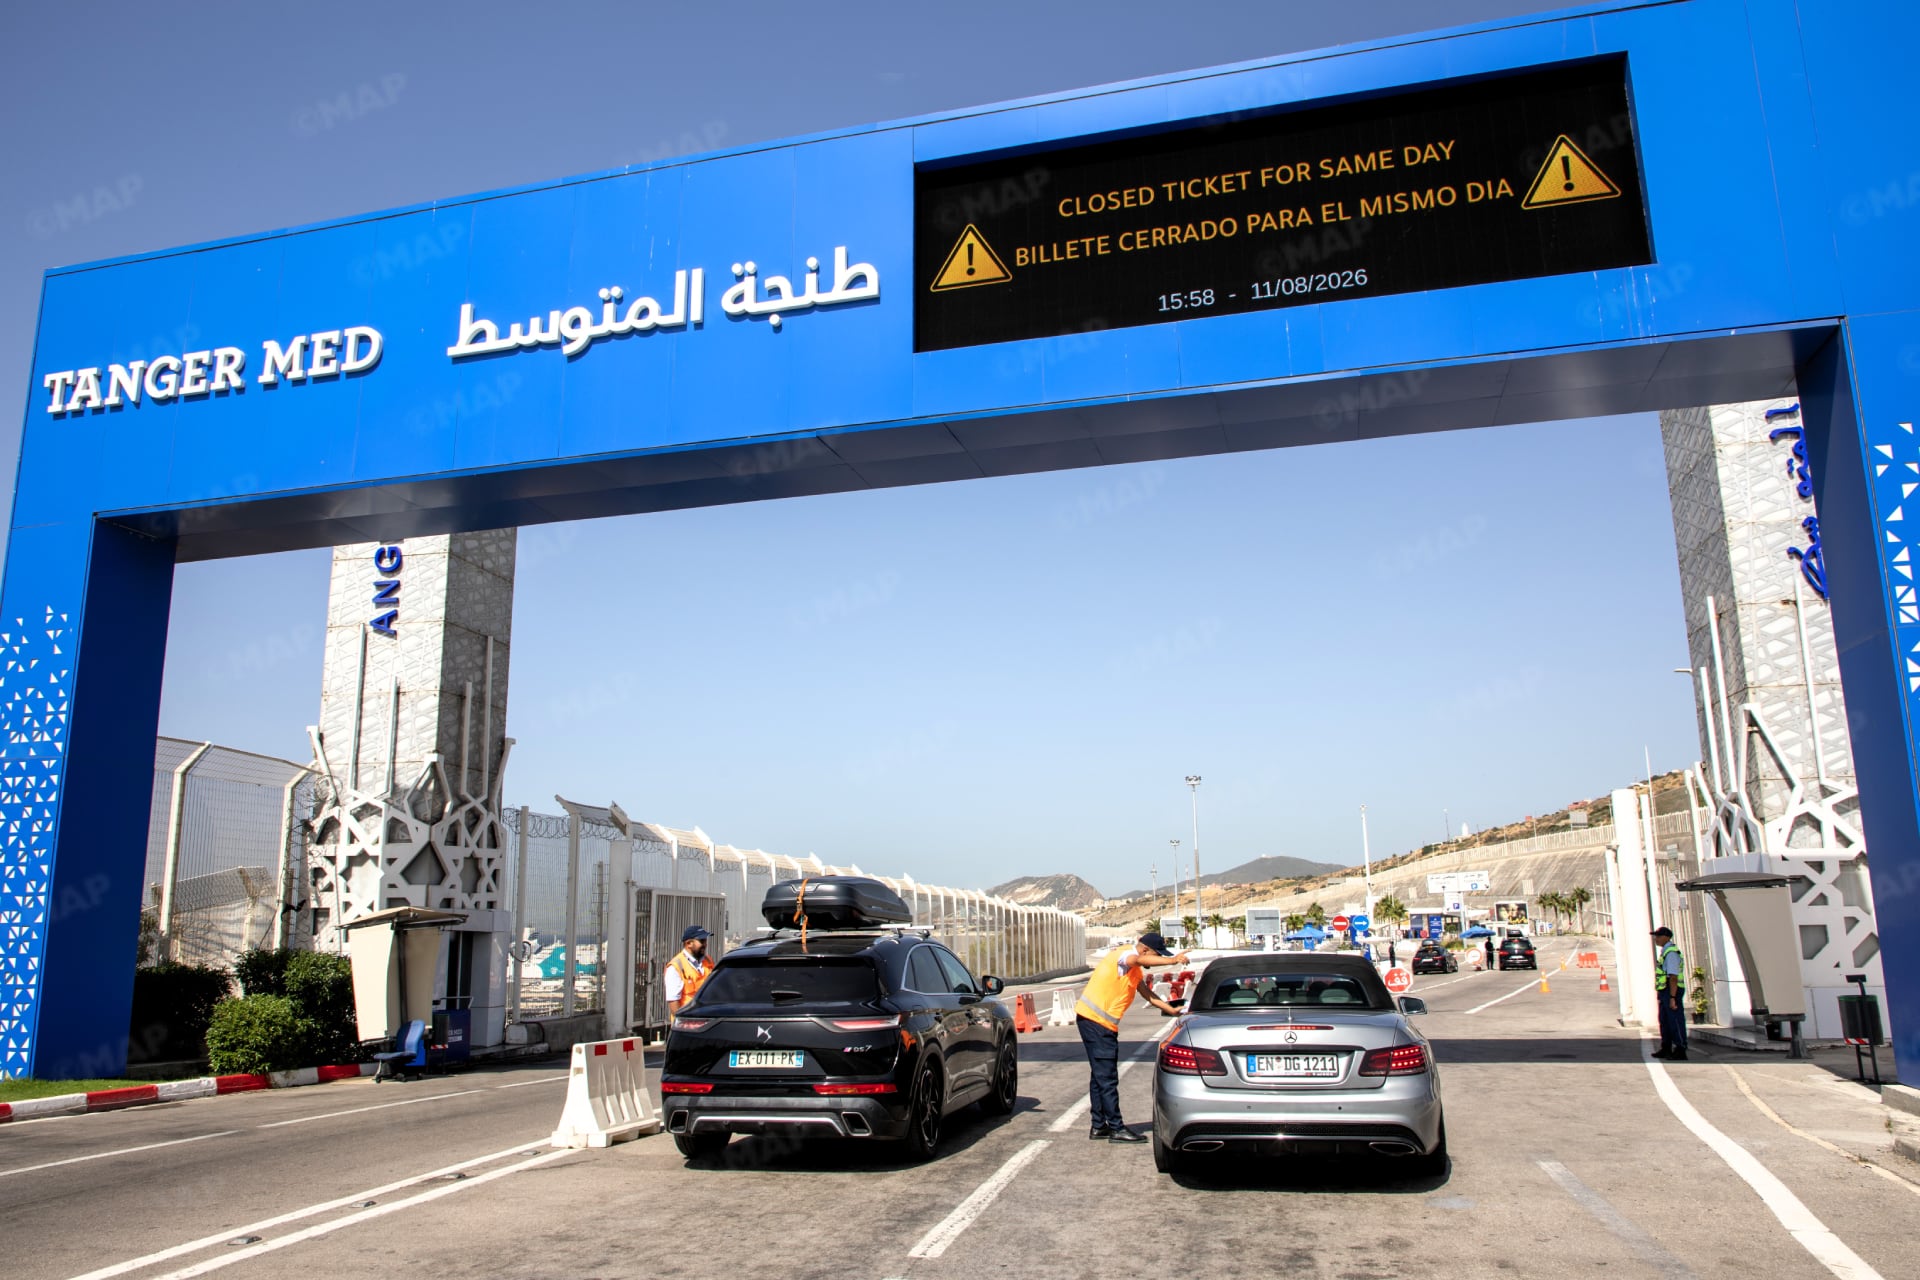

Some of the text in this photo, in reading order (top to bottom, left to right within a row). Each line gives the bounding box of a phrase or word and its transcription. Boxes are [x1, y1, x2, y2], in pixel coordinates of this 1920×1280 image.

[1058, 139, 1456, 217] CLOSED TICKET FOR SAME DAY
[1015, 177, 1515, 267] BILLETE CERRADO PARA EL MISMO DIA
[446, 245, 881, 357] طنجة المتوسط
[1158, 287, 1216, 312] 15:58
[1250, 267, 1369, 300] 11/08/2026
[43, 346, 246, 415] TANGER
[257, 325, 384, 384] MED
[369, 544, 402, 636] ANG
[738, 1052, 795, 1065] EX-011-PK
[1257, 1056, 1336, 1071] EN DG 1211
